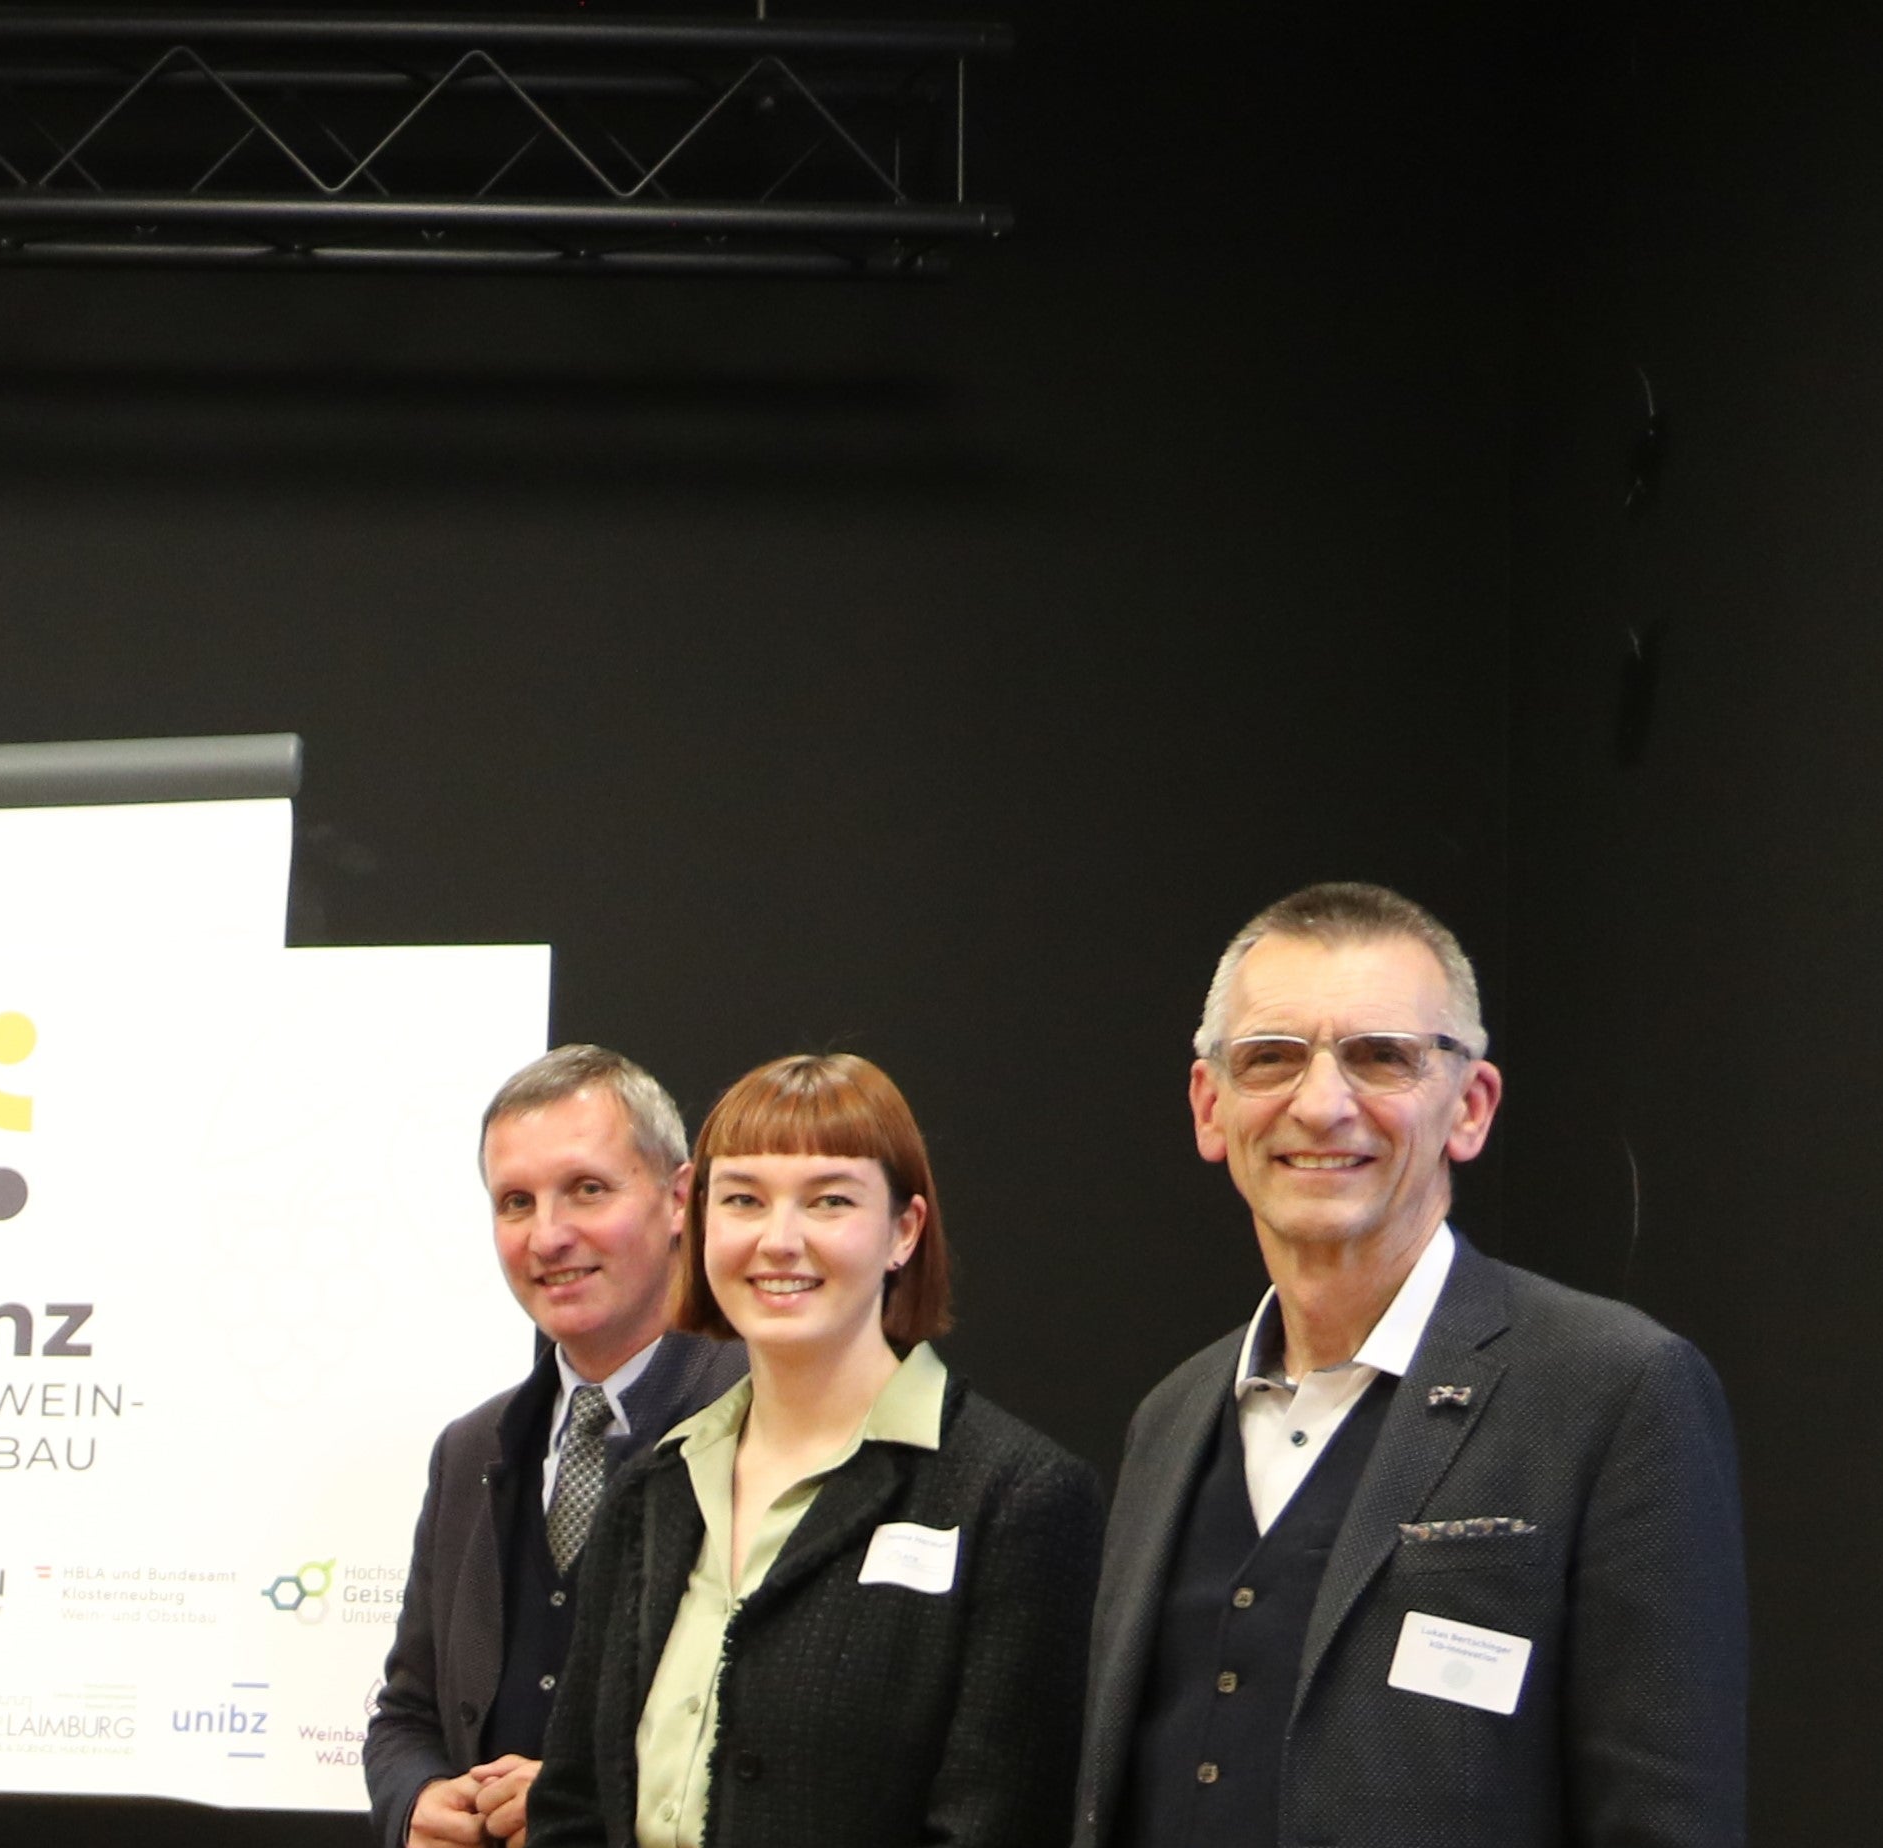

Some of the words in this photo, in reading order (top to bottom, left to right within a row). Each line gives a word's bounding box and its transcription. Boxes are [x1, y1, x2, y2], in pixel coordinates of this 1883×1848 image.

[63, 1566, 107, 1582] HBLA
[113, 1568, 140, 1581] und
[146, 1567, 238, 1583] Bundesamt
[62, 1588, 185, 1604] Klosterneuburg
[61, 1608, 105, 1622] Wein-
[112, 1609, 140, 1622] und
[147, 1609, 216, 1624] Obstbau
[5, 1713, 136, 1740] LAIMBURG
[172, 1702, 268, 1734] unibz
[316, 1746, 364, 1766] WÄD
